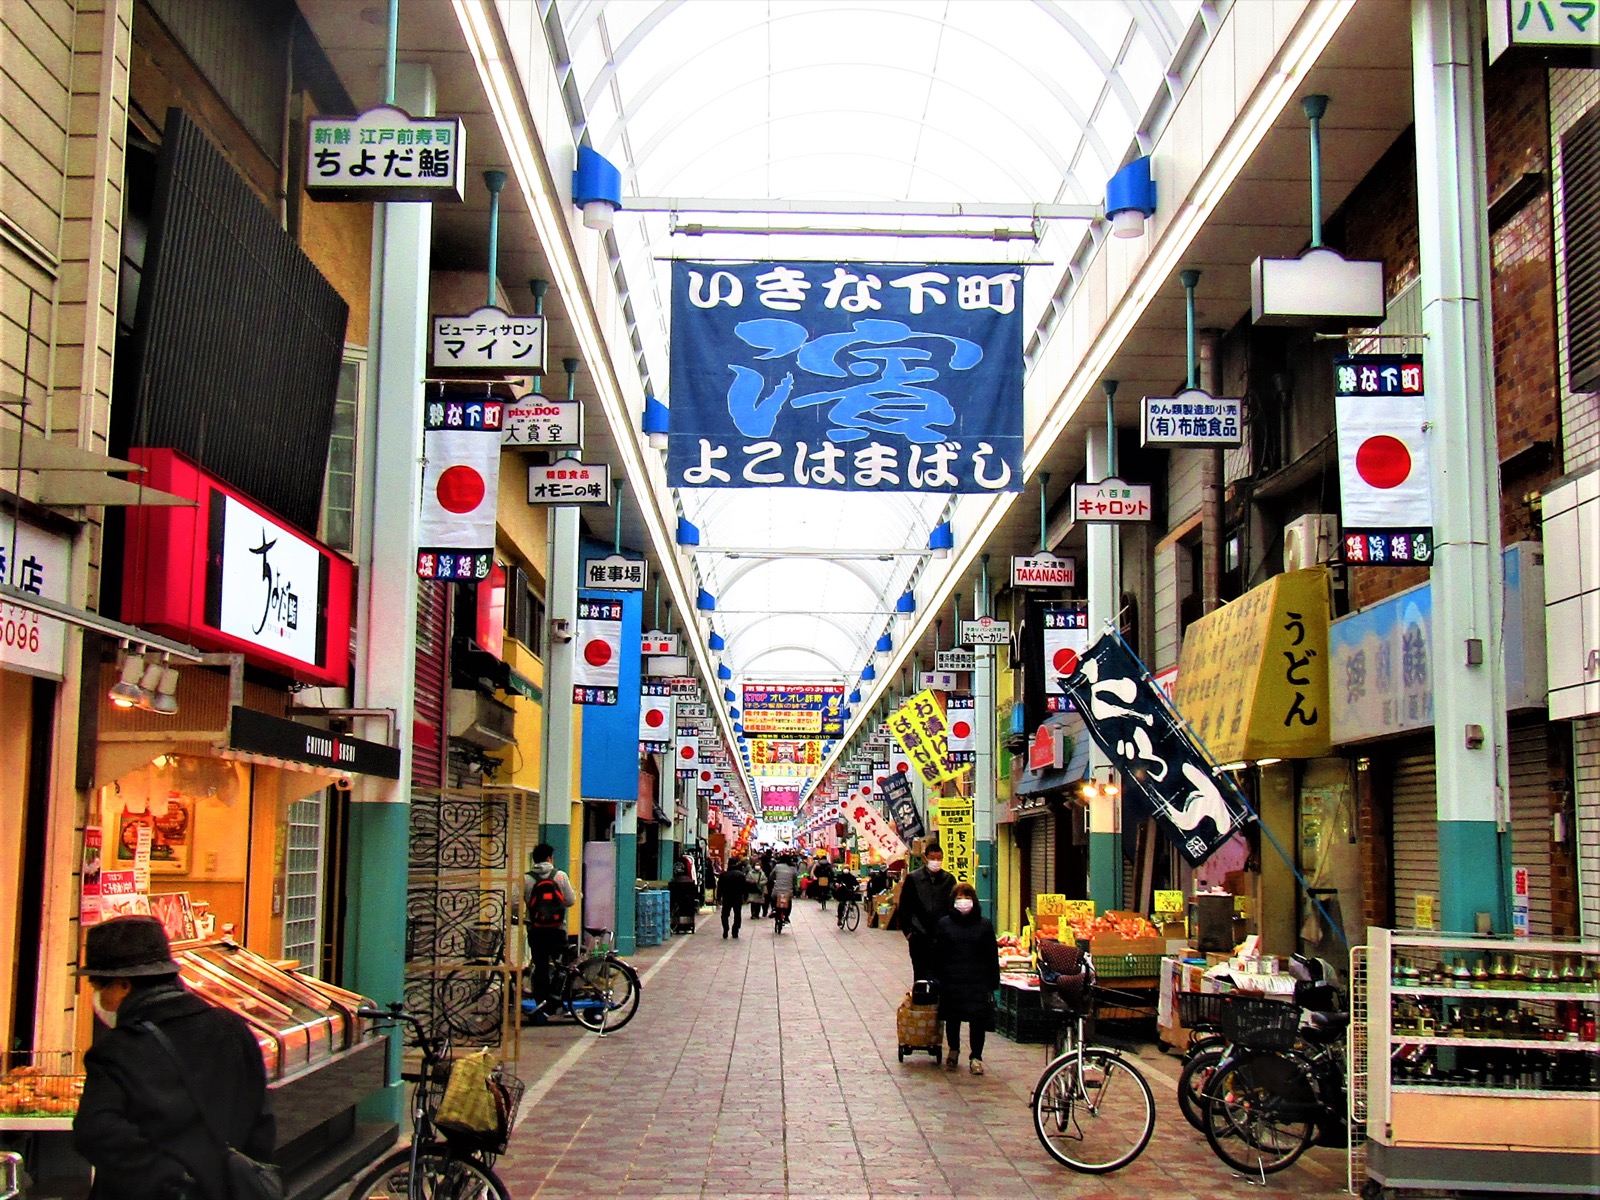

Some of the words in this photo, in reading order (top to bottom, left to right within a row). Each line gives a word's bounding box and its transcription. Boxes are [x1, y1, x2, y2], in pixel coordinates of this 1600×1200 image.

[314, 128, 351, 145] 新鮮
[360, 128, 450, 145] 江戸前寿司
[314, 148, 450, 178] ちよだ鮨
[688, 267, 1021, 315] いきな下町
[439, 324, 538, 336] ビューティサロン
[444, 340, 532, 359] マイン
[1338, 367, 1420, 391] 粋な下町
[429, 403, 500, 426] 粋な下町
[508, 407, 559, 418] pixy.DOG
[1150, 404, 1237, 415] めん類製造卸小売
[505, 424, 562, 442] 大賞堂
[1149, 417, 1237, 437] (有)布施食品
[683, 438, 1011, 489] よこはまばし
[546, 470, 589, 479] 韓国食品
[534, 482, 602, 498] オモニの味
[1097, 489, 1131, 498] 八百屋
[1079, 499, 1149, 515] キャロット
[590, 565, 641, 583] 催事場
[1016, 569, 1073, 582] TAKANASHI
[964, 632, 1008, 642] 丸十ベーカリー
[1284, 612, 1319, 727] うどん
[770, 693, 823, 702] オレオレ詐欺
[306, 735, 332, 758] CHIYODA
[339, 743, 356, 762] SUSHI
